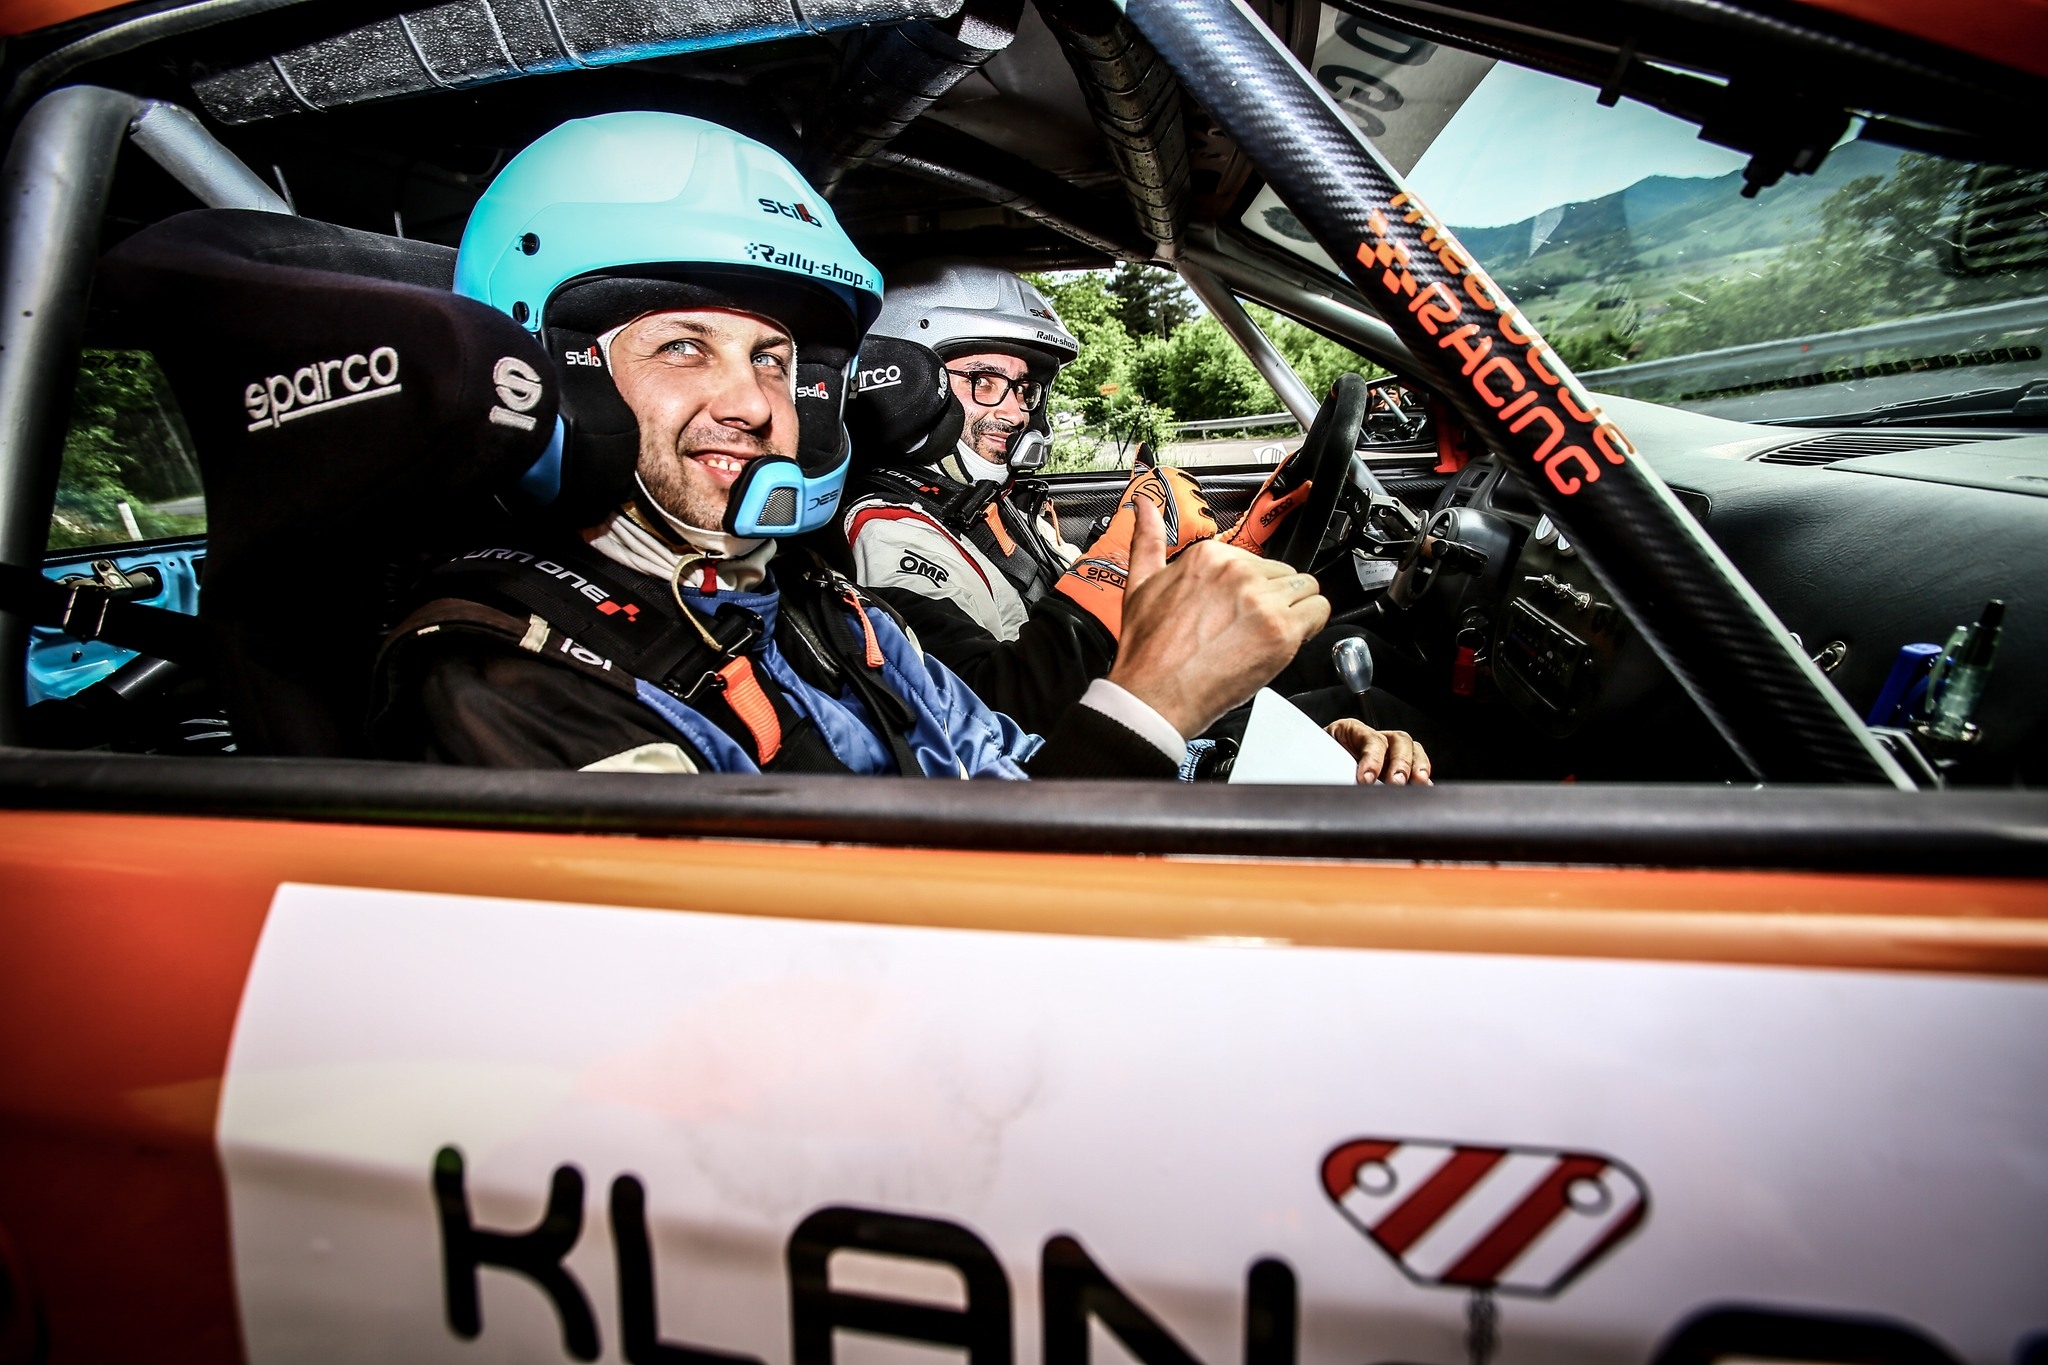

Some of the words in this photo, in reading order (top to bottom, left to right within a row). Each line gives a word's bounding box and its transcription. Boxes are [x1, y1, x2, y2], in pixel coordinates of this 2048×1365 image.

[245, 346, 400, 429] sparco
[1408, 281, 1600, 495] RACING
[1260, 497, 1294, 528] sparco
[899, 555, 949, 583] OMP
[1087, 566, 1126, 586] spar
